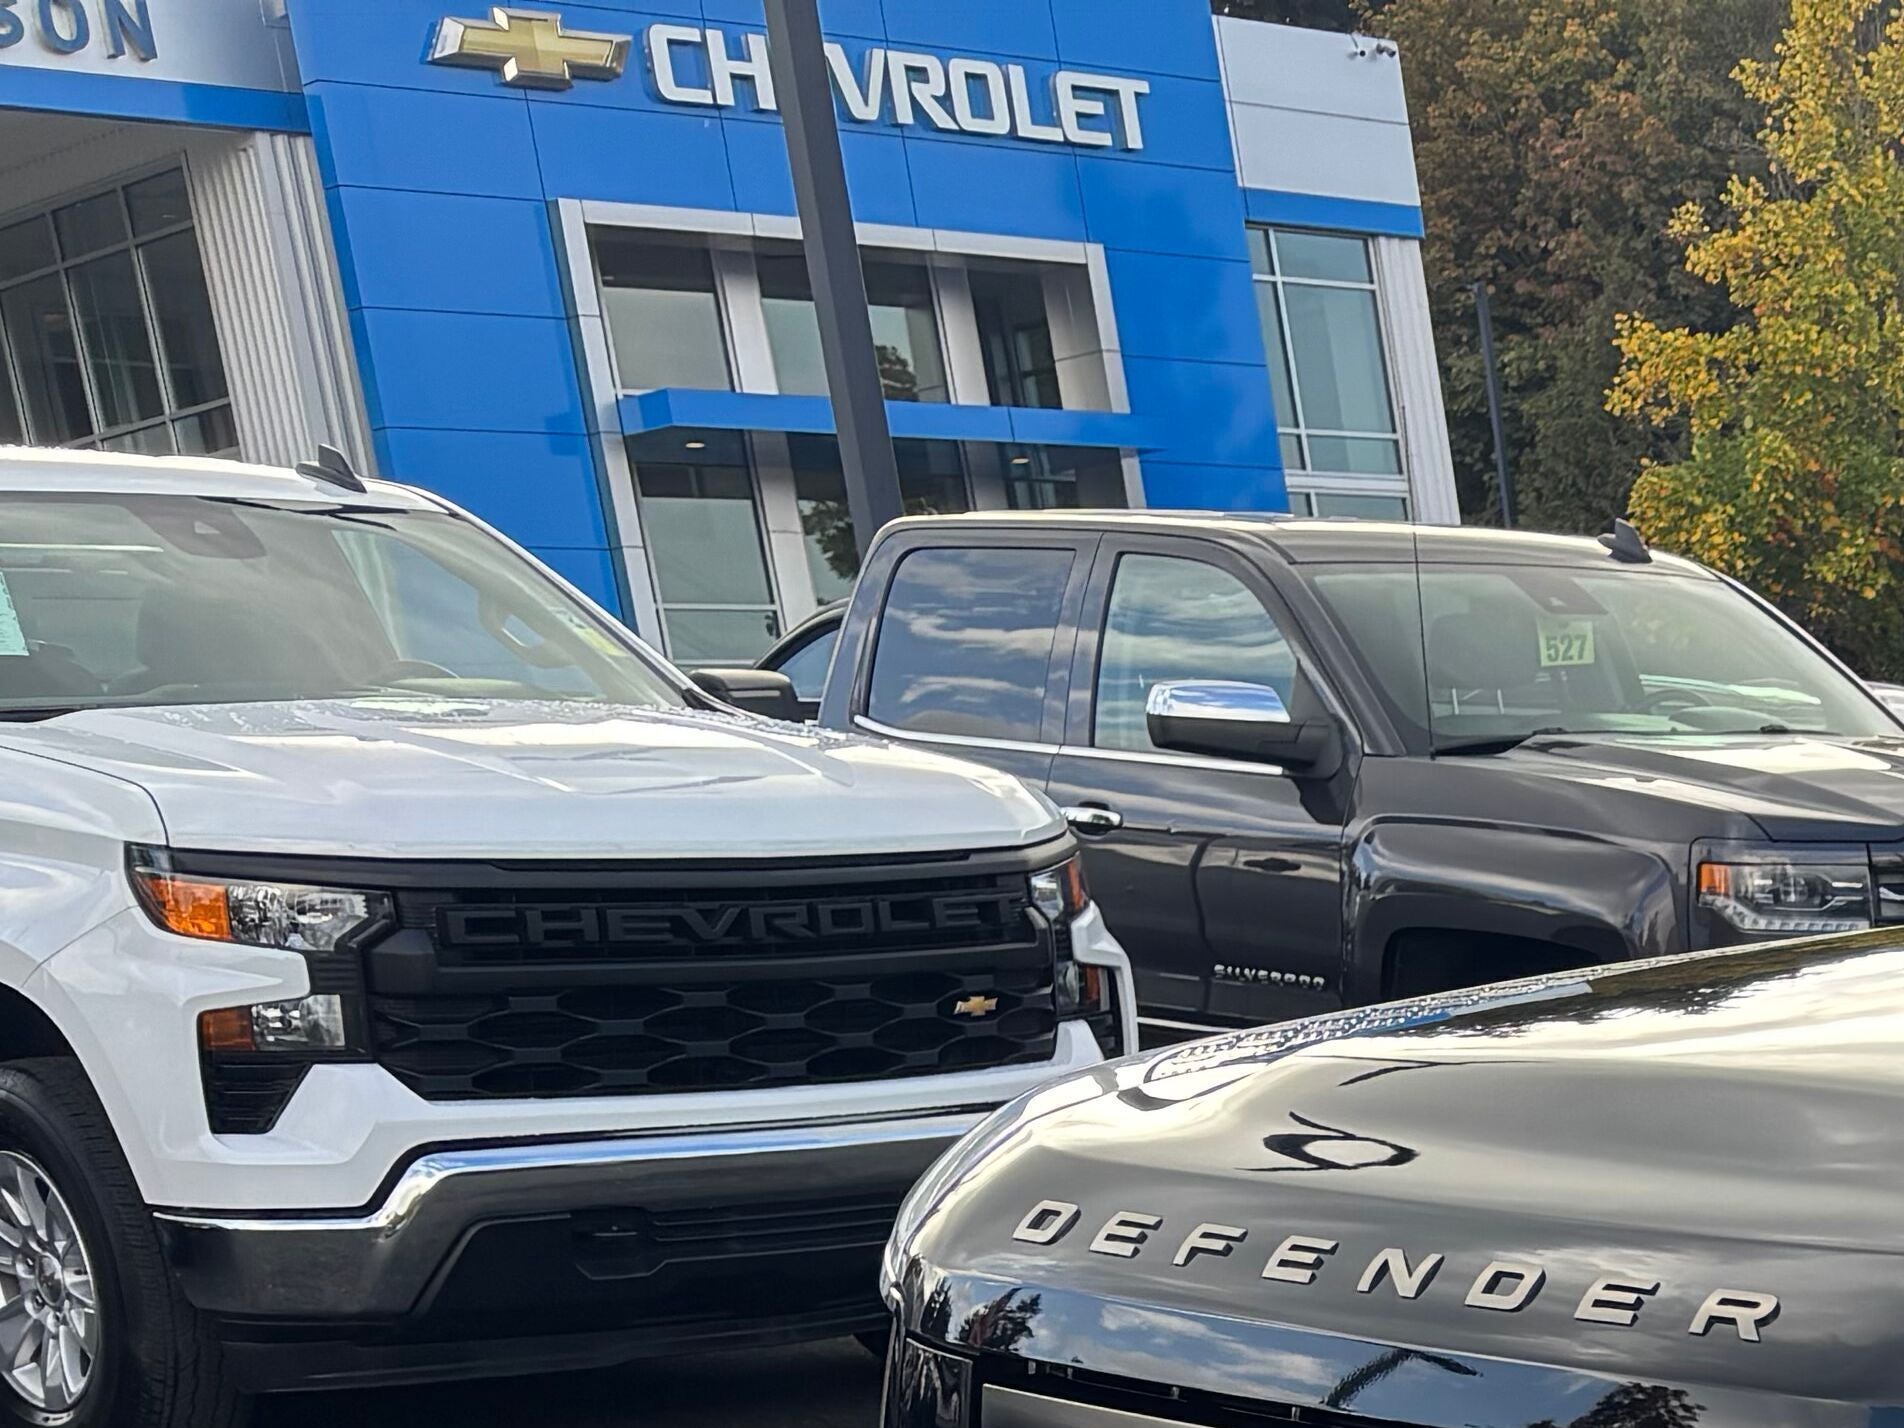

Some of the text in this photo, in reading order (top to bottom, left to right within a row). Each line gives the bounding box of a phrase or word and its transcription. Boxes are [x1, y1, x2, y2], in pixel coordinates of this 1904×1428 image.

[646, 24, 1150, 149] CHVROLET
[1545, 634, 1587, 662] 527
[440, 893, 1025, 947] CHEVROLET
[1012, 1198, 1782, 1344] DEFENDER
